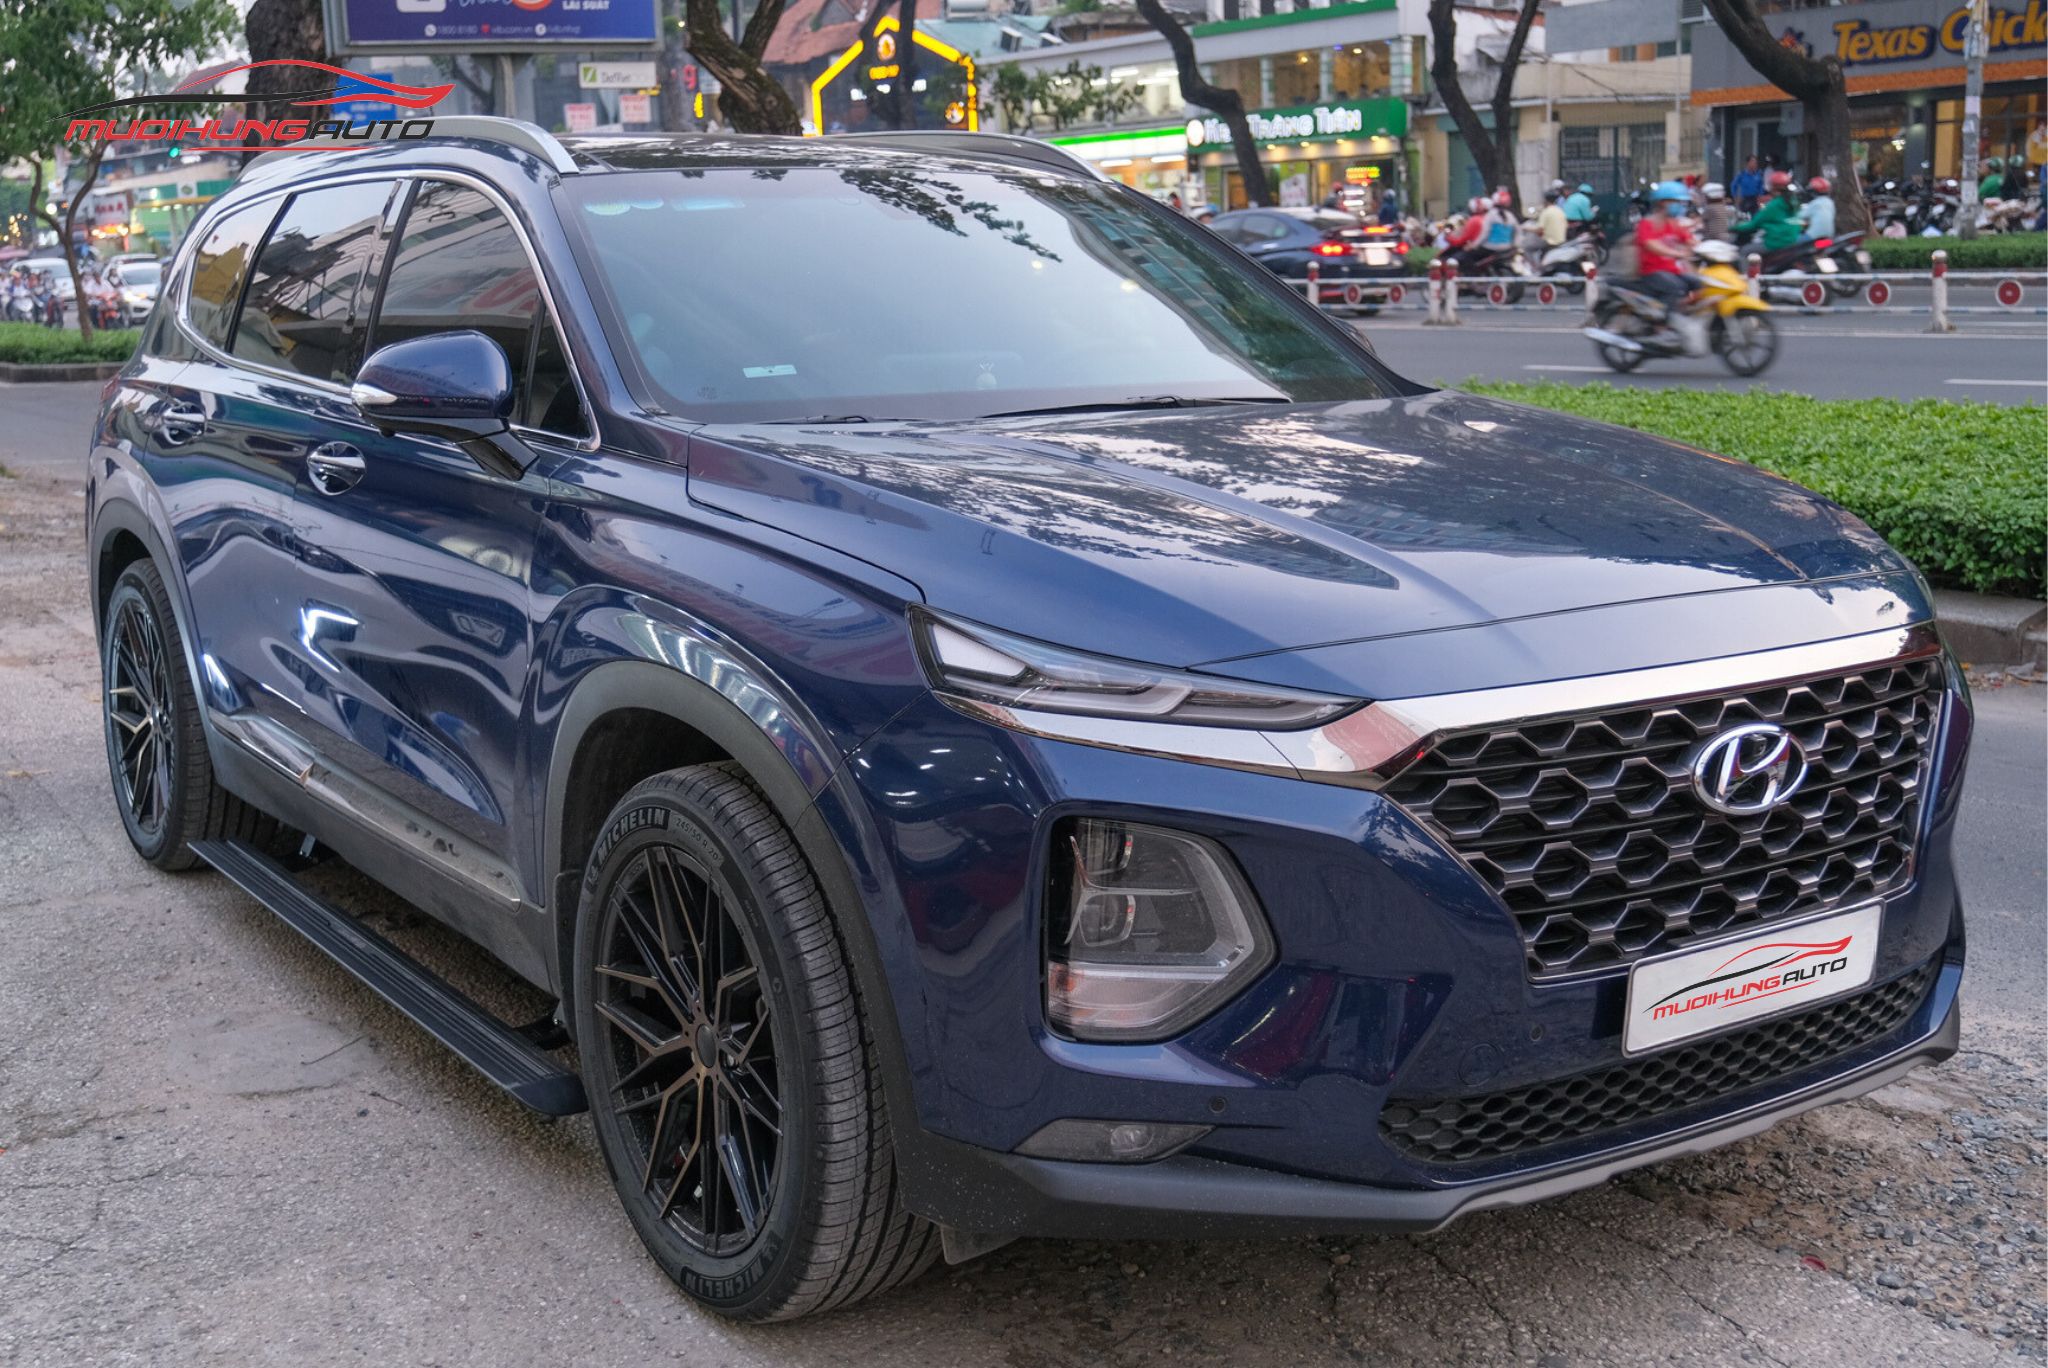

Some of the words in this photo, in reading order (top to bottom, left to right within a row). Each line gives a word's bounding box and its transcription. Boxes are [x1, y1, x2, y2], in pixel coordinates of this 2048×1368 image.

[1834, 20, 1934, 63] Texas
[1940, 0, 2047, 52] Cick
[597, 807, 666, 862] MICHELIN
